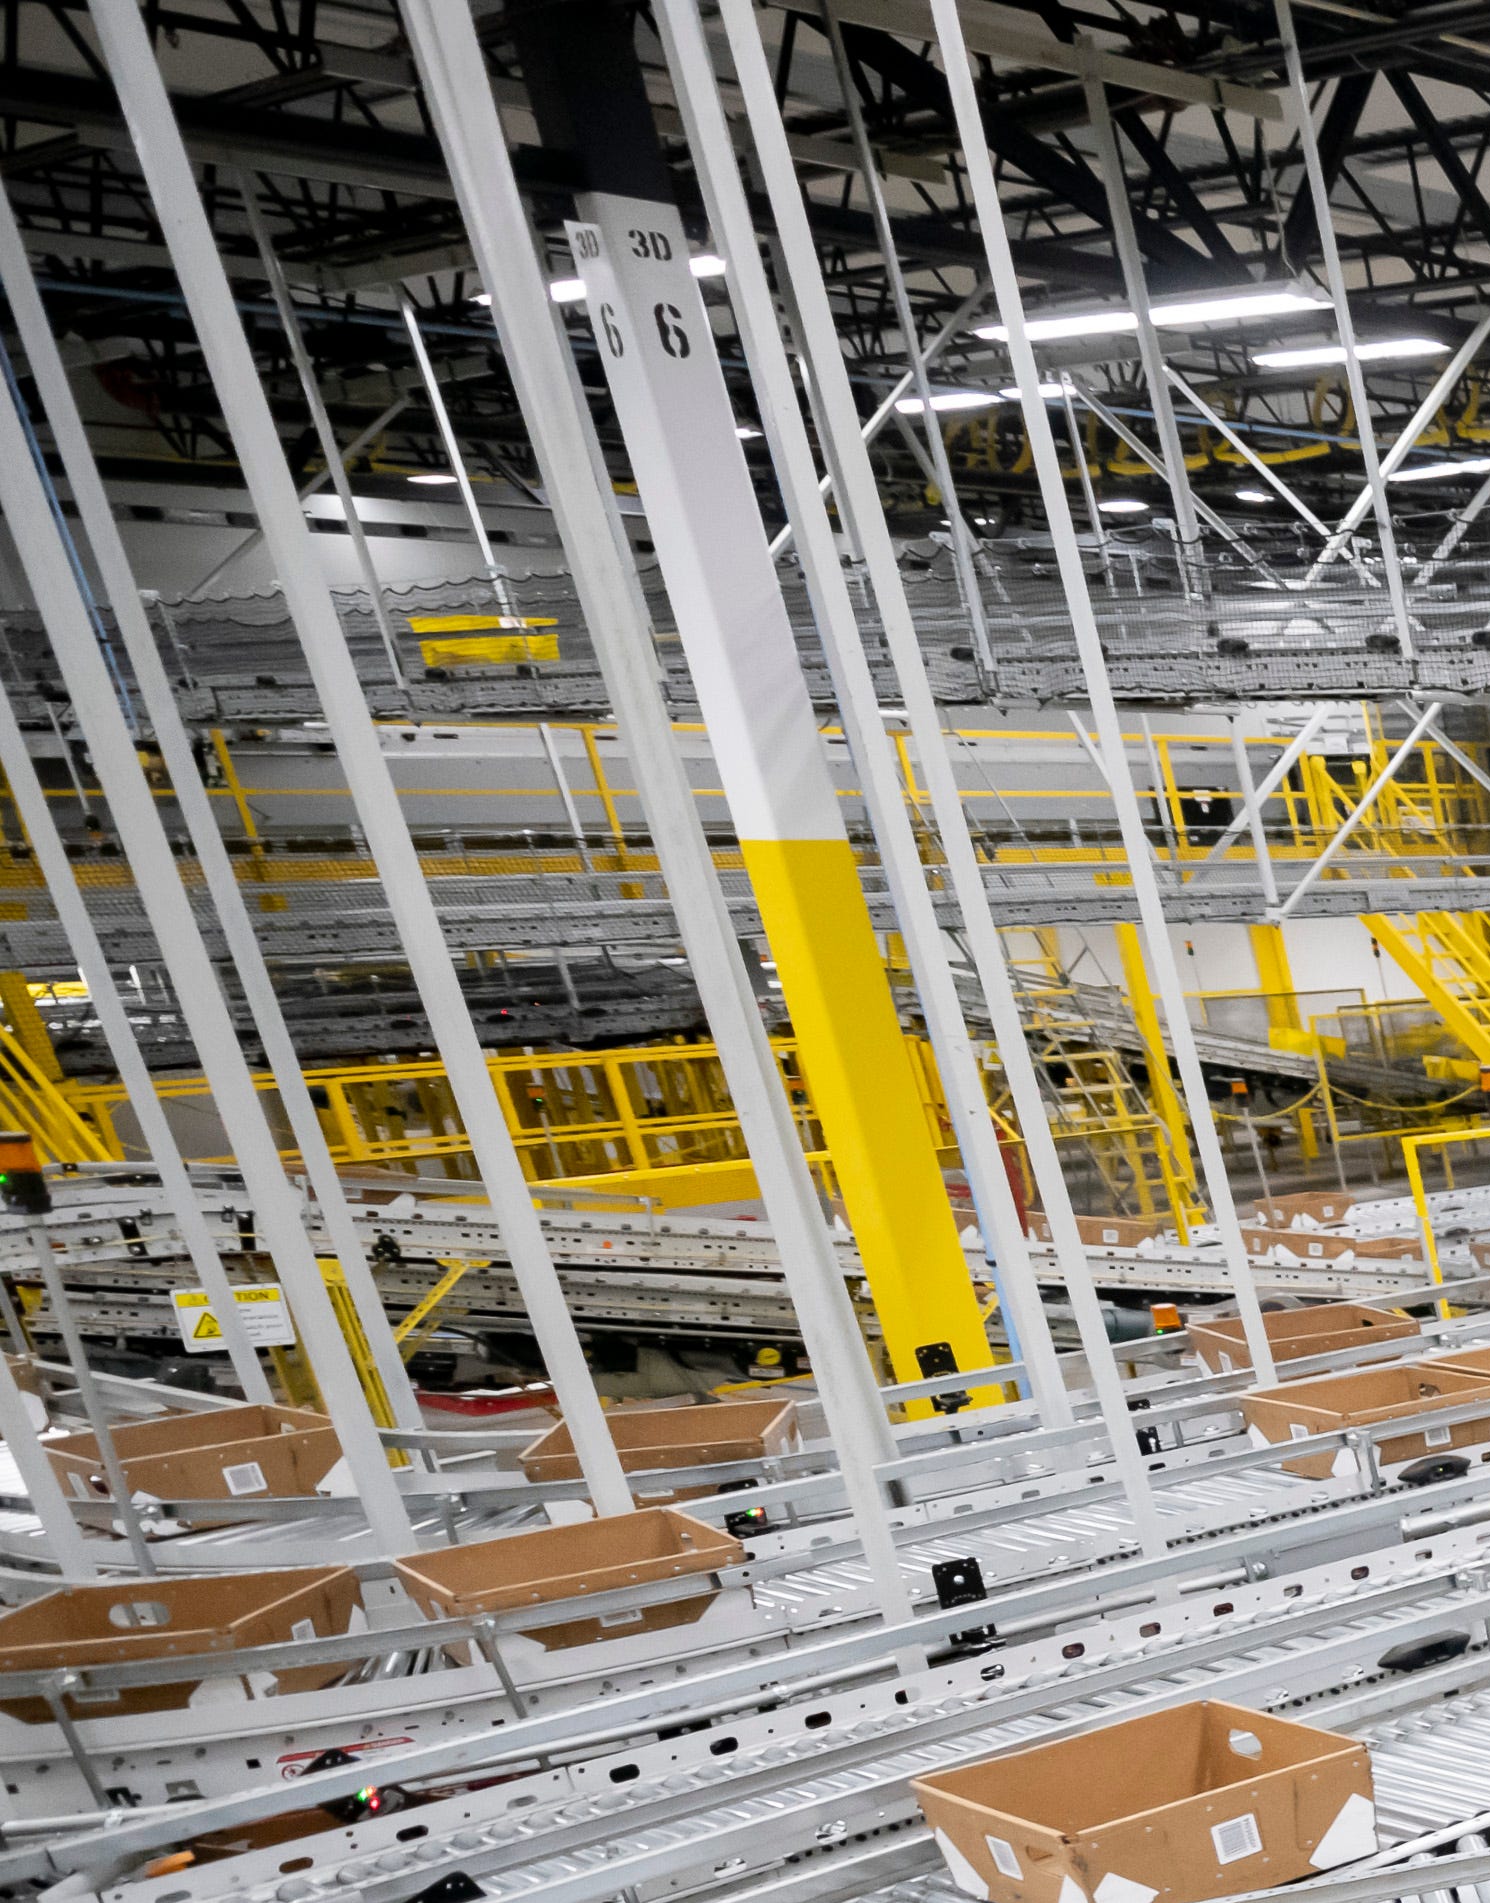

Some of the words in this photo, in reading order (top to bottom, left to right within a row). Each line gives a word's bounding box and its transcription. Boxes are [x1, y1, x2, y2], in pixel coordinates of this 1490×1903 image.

[628, 229, 673, 262] 3D
[600, 302, 624, 359] 6
[653, 302, 691, 359] 6
